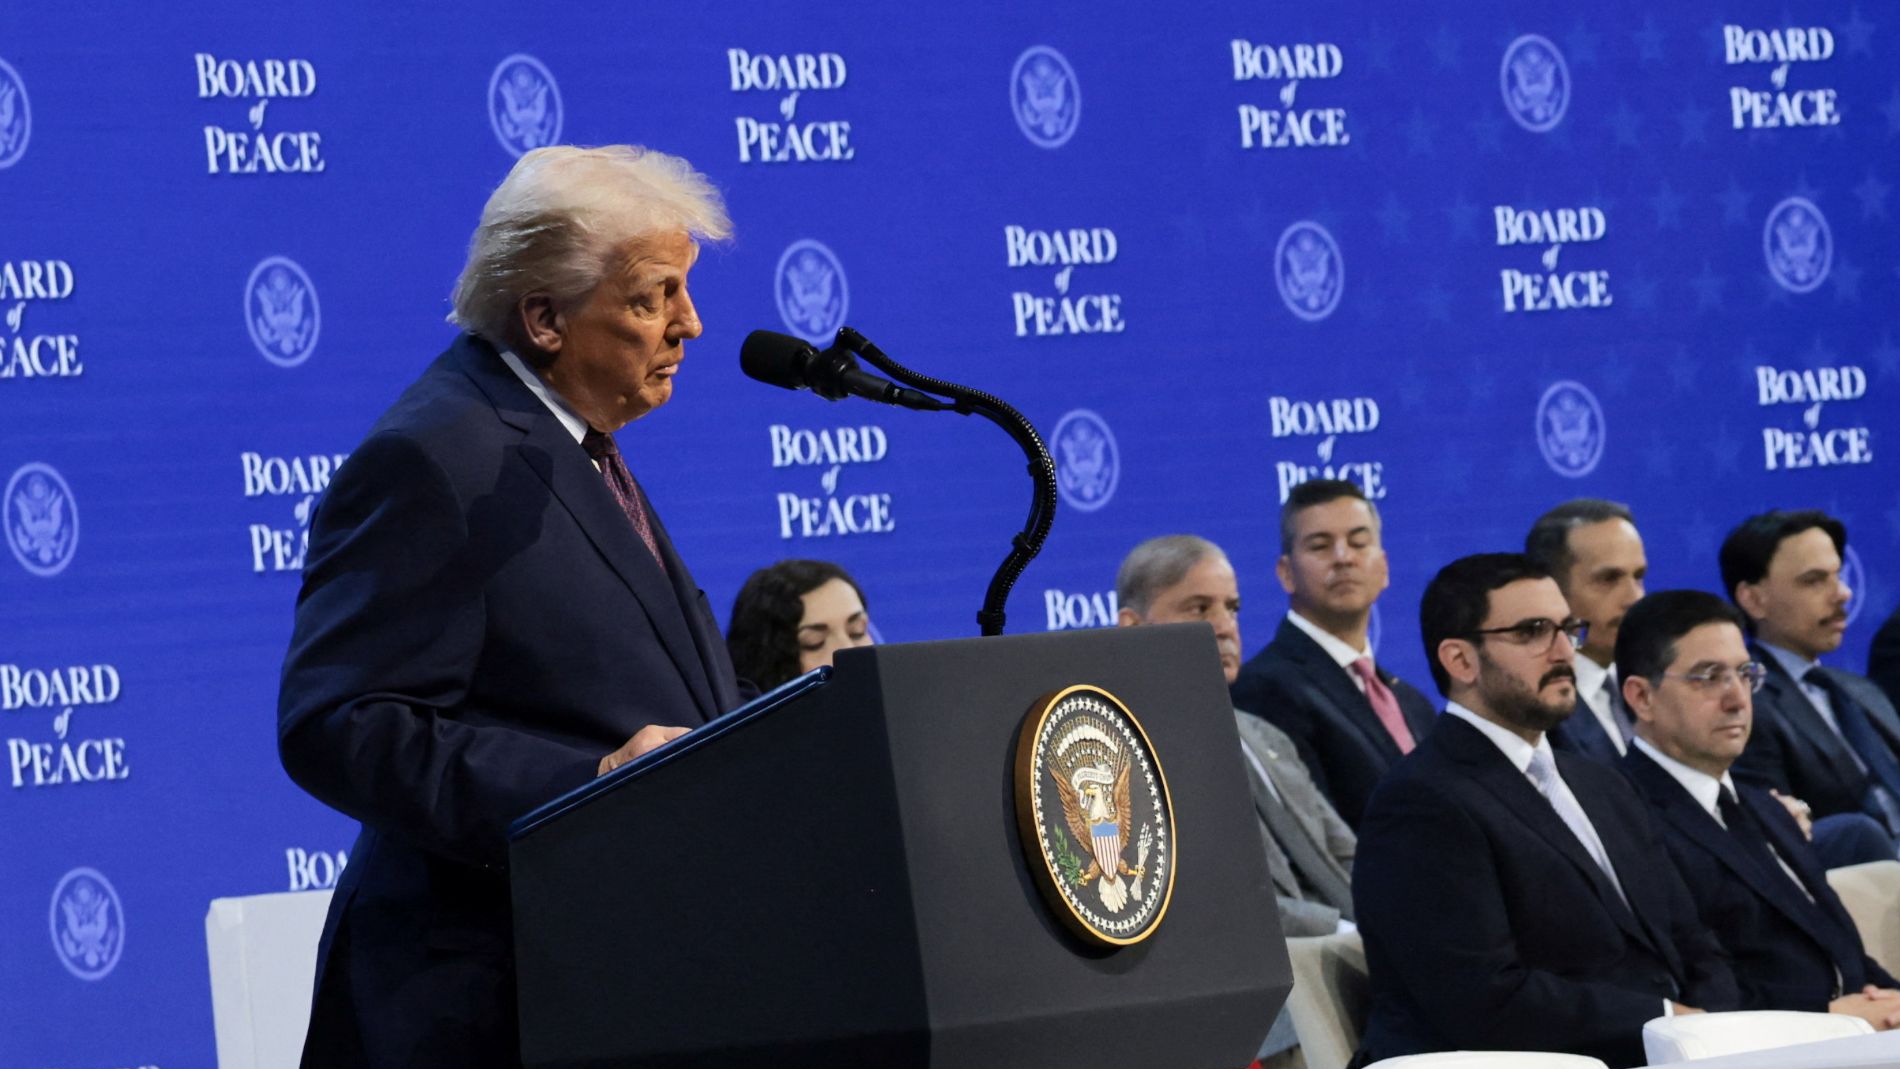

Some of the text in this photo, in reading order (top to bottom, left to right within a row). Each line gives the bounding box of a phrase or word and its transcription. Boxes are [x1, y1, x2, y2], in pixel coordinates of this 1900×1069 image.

[1231, 39, 1343, 80] BOARD
[1723, 24, 1834, 64] BOARD
[194, 53, 316, 97] BOARD
[727, 48, 846, 91] BOARD
[1770, 63, 1789, 89] of
[779, 91, 800, 121] of
[1279, 80, 1297, 107] of
[1730, 86, 1840, 129] PEACE
[249, 99, 268, 130] of
[1238, 104, 1350, 148] PEACE
[203, 127, 325, 174] PEACE
[735, 116, 854, 163] PEACE
[1004, 225, 1118, 268] BOARD
[1494, 205, 1606, 247] BOARD
[1542, 245, 1560, 271] of
[0, 260, 74, 299] ARD
[1054, 266, 1072, 294] of
[1500, 270, 1613, 312] PEACE
[6, 300, 26, 333] of
[1012, 293, 1125, 337] PEACE
[0, 335, 83, 378] ACE
[1756, 365, 1867, 405] BOARD
[1268, 396, 1380, 437] BOARD
[1803, 402, 1821, 429] of
[769, 424, 887, 469] BOARD
[1317, 435, 1336, 463] of
[1763, 427, 1872, 470] PEACE
[821, 465, 841, 495] of
[294, 495, 314, 527] of
[777, 492, 895, 539] PEACE
[1044, 589, 1119, 630] BOA
[0, 664, 120, 710] BOARD
[54, 707, 73, 740] of
[7, 738, 129, 787] PEACE
[286, 847, 348, 891] BOA
